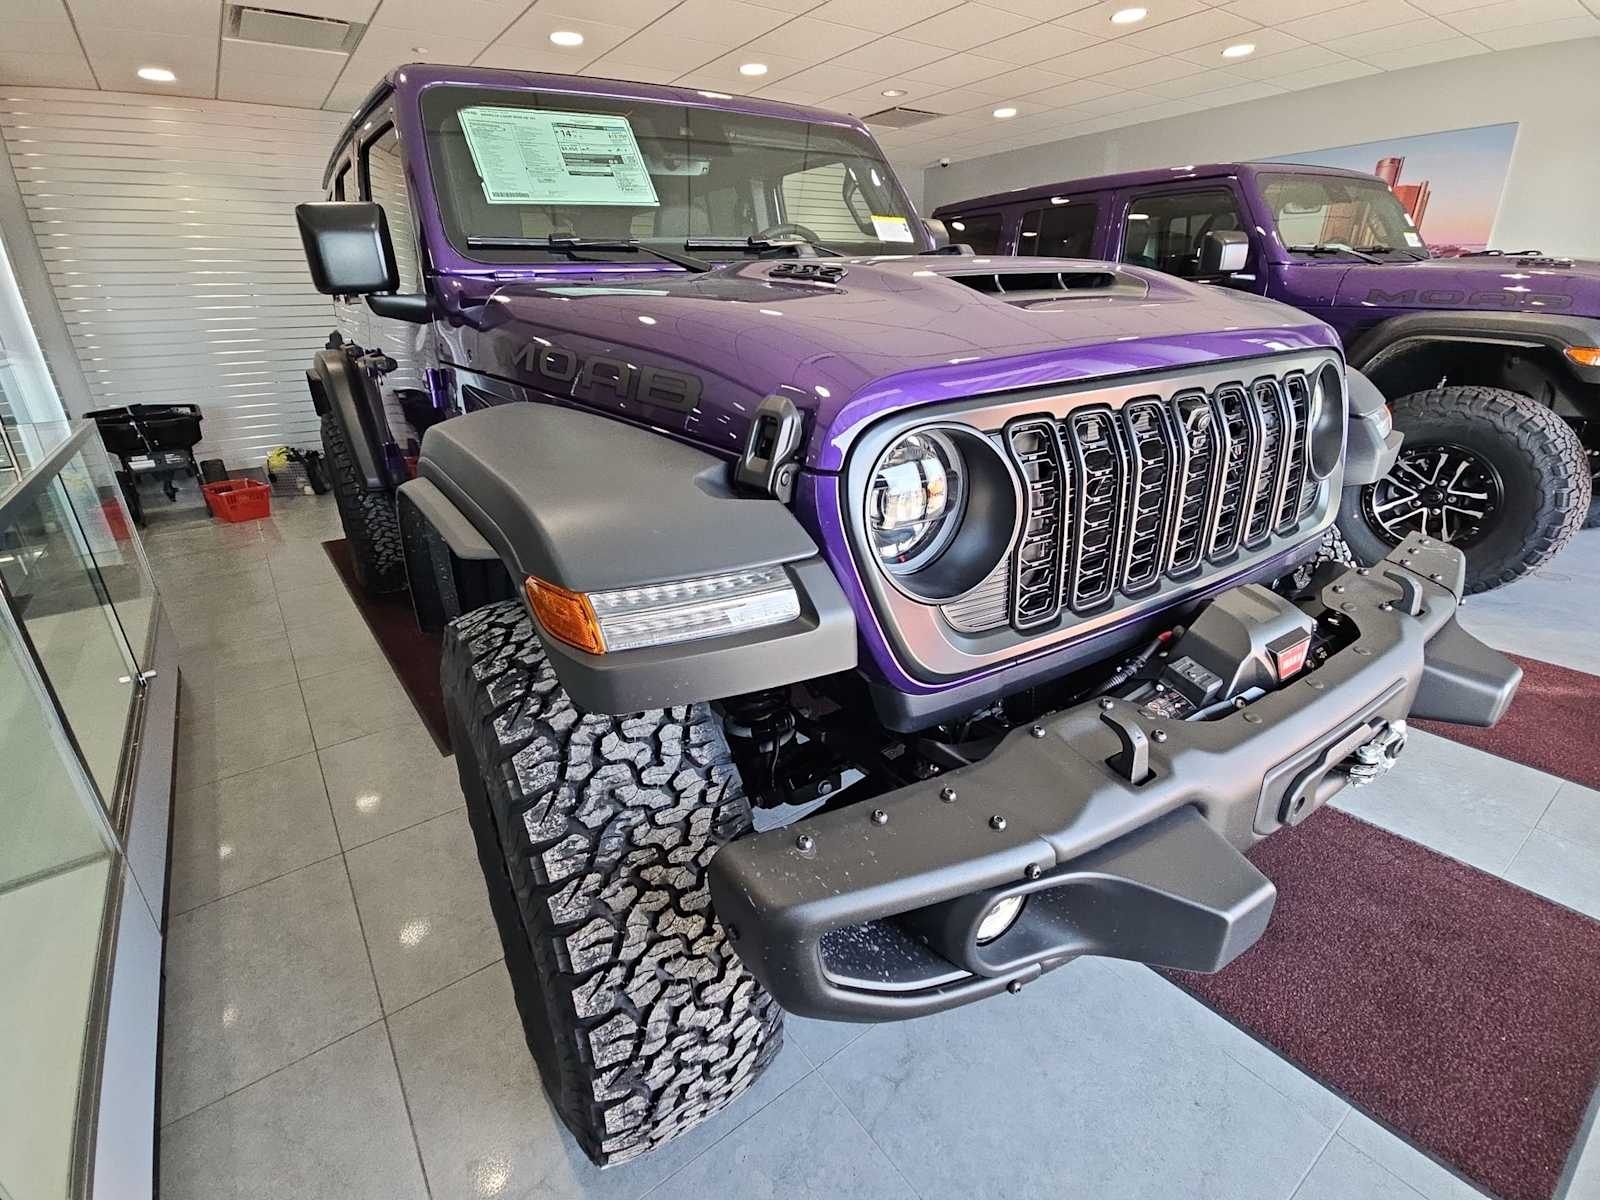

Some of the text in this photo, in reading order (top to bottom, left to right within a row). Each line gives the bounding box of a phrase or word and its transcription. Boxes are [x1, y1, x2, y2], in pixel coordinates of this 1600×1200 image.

[560, 129, 572, 137] 14
[1366, 289, 1574, 310] MOAB
[496, 337, 703, 411] MOAB
